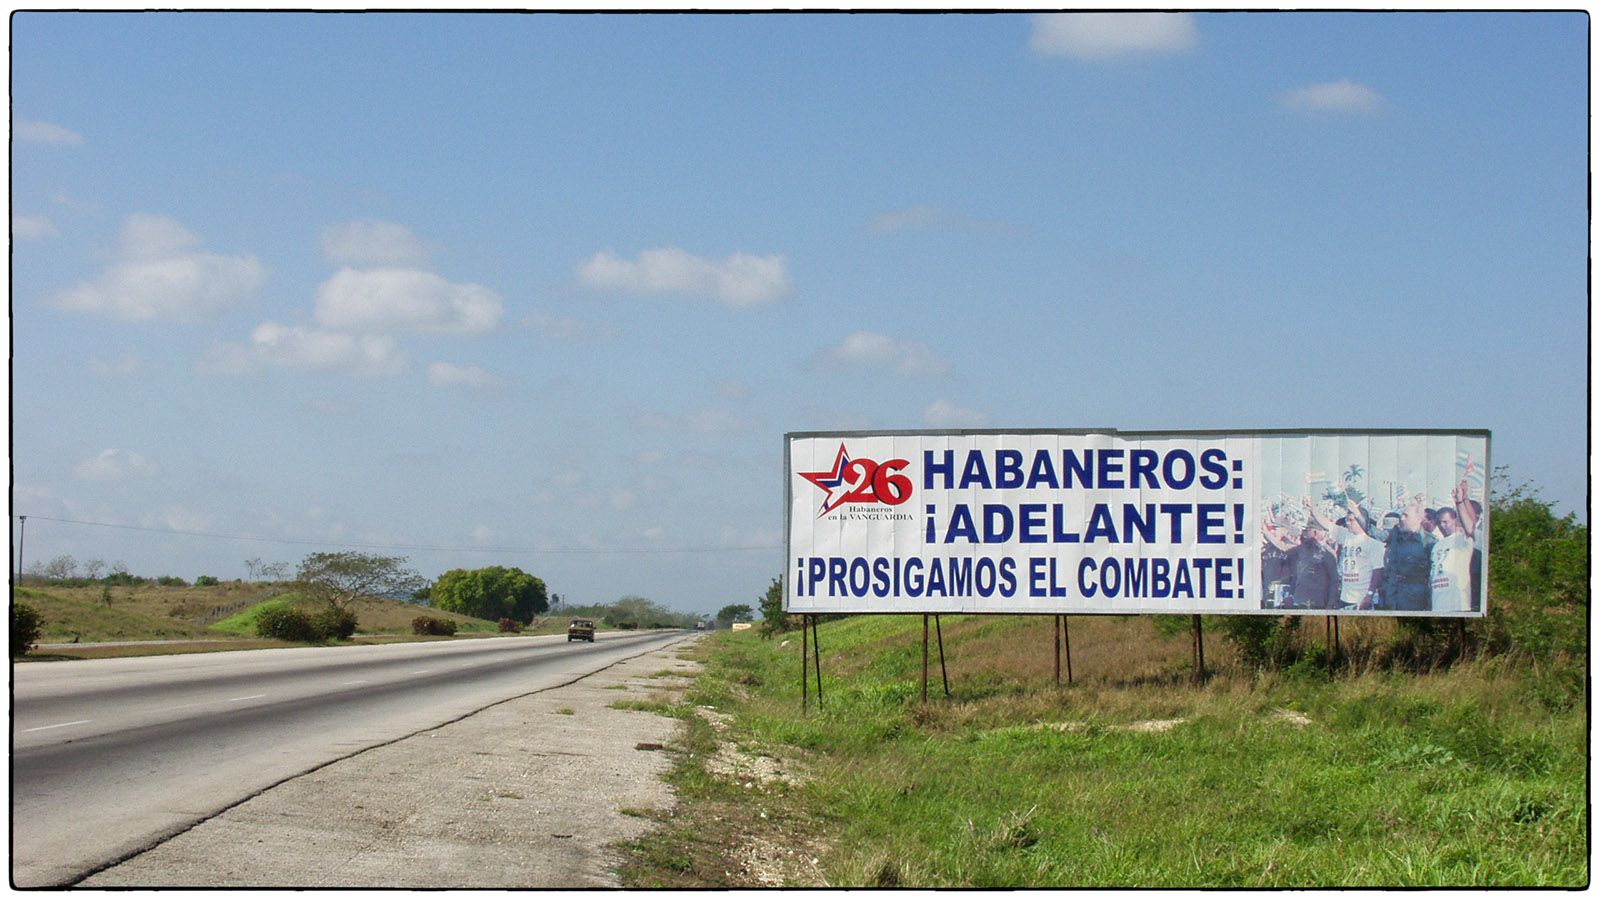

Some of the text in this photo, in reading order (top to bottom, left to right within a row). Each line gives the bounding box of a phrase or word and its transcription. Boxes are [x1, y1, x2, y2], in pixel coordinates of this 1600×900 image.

[843, 458, 913, 505] 26
[924, 448, 1243, 490] HABANEROS:
[925, 503, 1245, 544] ¡ADELANTE!
[797, 557, 1245, 598] ¡PROSIGAMOS EL COMBATE!
